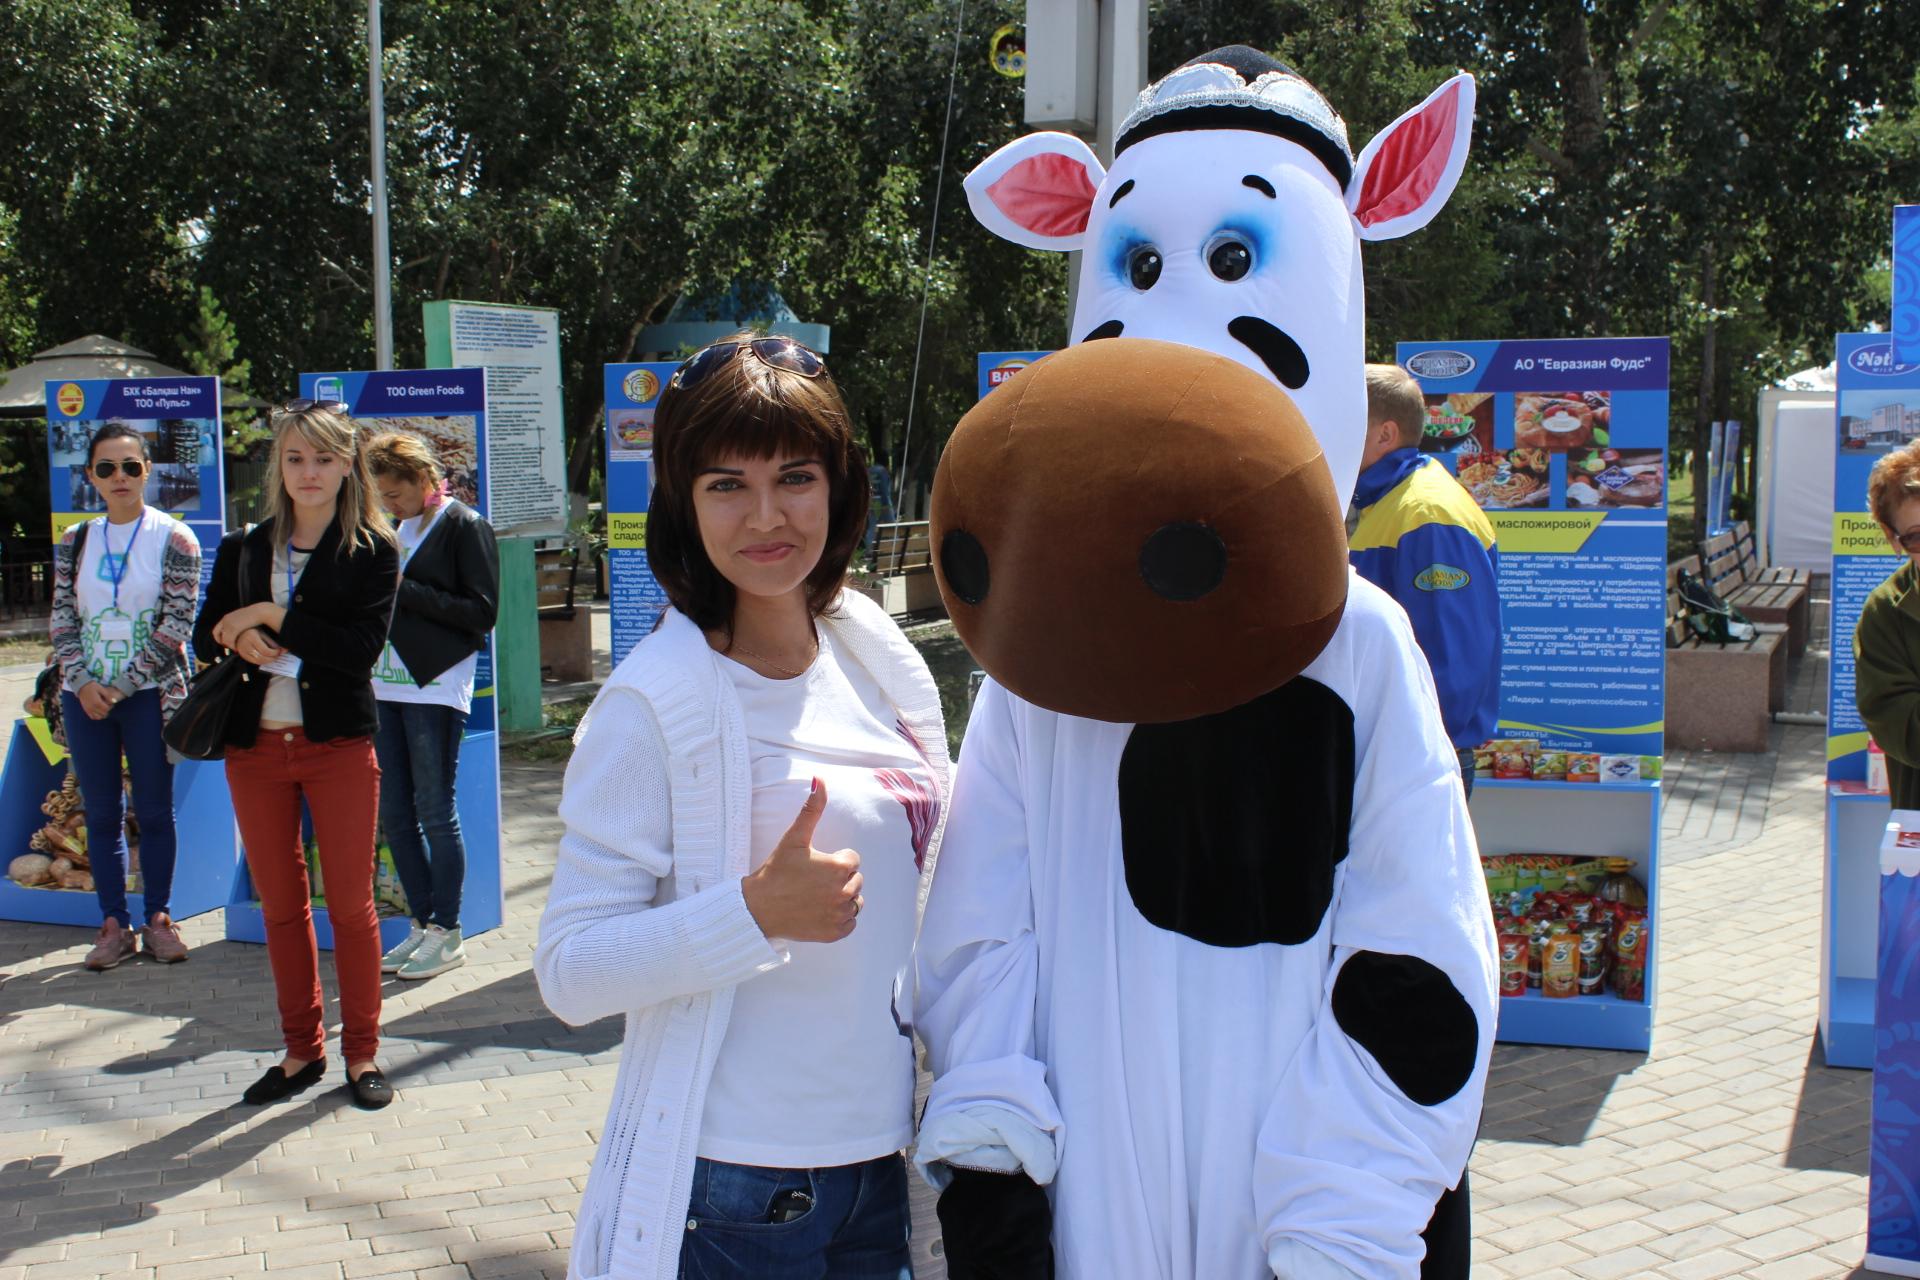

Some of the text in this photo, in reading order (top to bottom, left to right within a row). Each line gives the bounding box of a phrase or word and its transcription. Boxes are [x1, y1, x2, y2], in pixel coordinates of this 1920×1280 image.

[1514, 356, 1652, 371] АО "Евразиан Фудс"
[408, 386, 434, 396] Green
[436, 385, 465, 396] Foods
[134, 398, 191, 409] ТОО «Пульс»
[1496, 517, 1592, 531] масложировой
